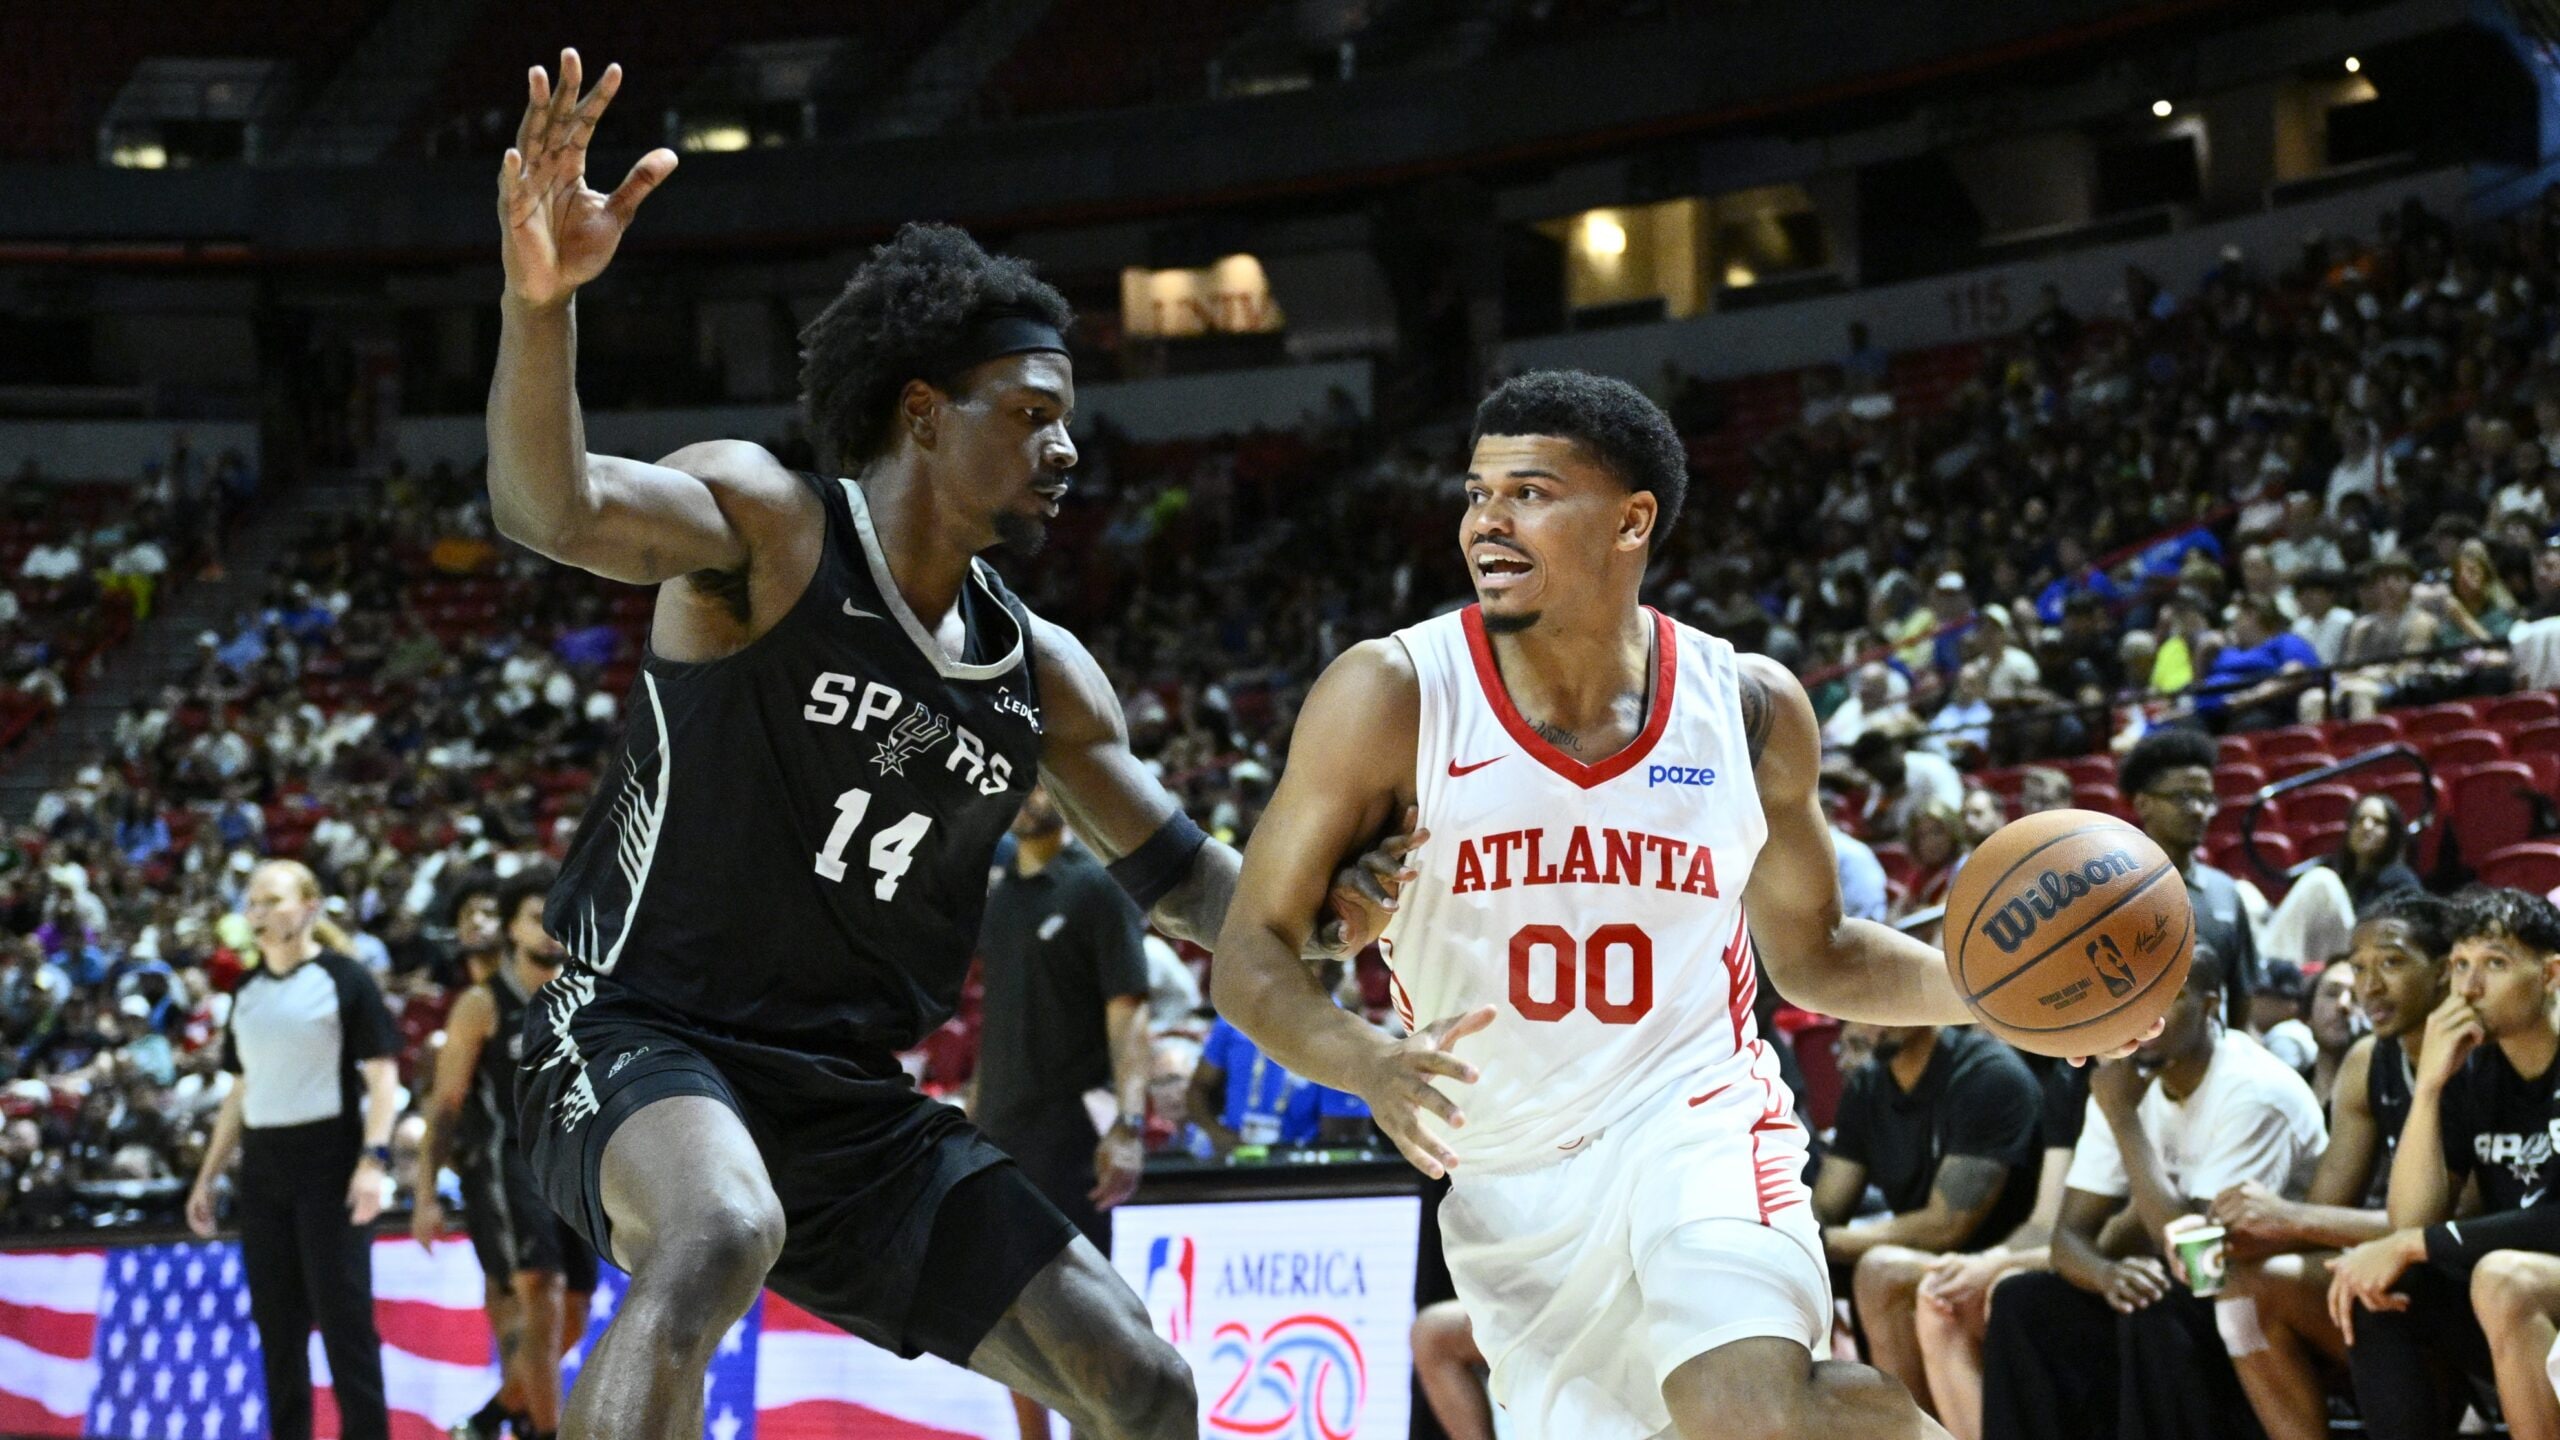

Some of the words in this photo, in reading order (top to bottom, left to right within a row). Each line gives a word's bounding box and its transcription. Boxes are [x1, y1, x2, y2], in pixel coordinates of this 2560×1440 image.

[804, 671, 1012, 796] SPURS
[1649, 765, 1716, 788] paze
[814, 787, 933, 902] 14
[1452, 825, 1719, 899] ATLANTA
[1981, 848, 2141, 953] Wilson
[1508, 923, 1653, 1024] 00
[1218, 1252, 1366, 1297] AMERICA
